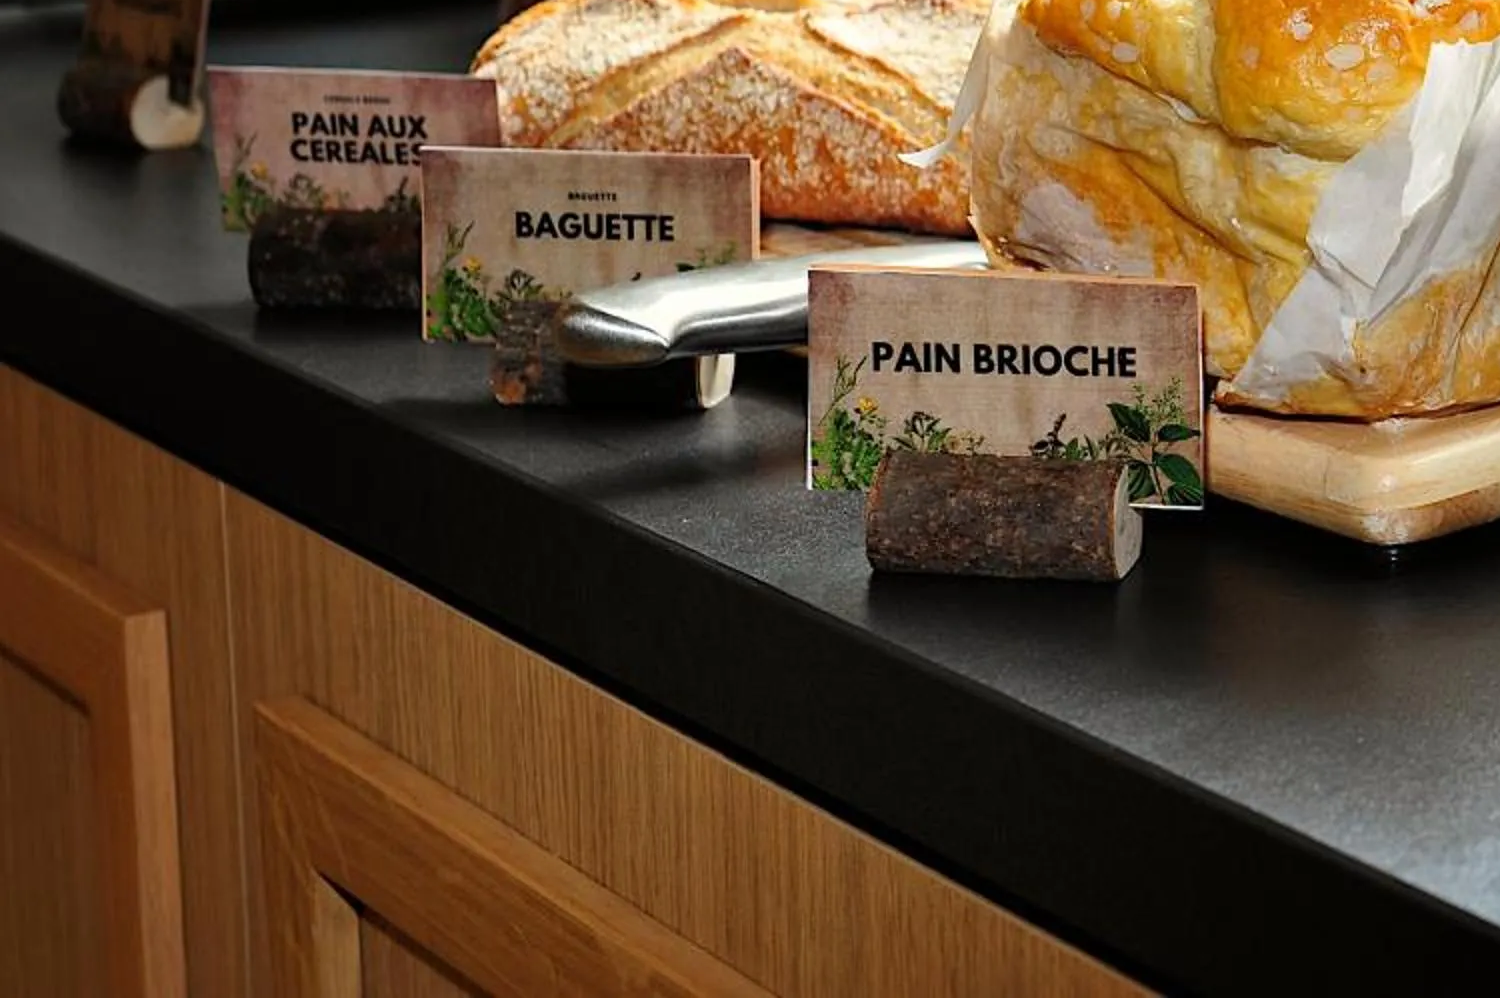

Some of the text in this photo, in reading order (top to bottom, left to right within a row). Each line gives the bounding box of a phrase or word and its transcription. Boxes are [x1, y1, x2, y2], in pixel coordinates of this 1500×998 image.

[291, 112, 428, 139] PAIN AUX
[567, 191, 617, 202] BAGUETTE
[515, 211, 675, 242] BAGUETTE
[871, 341, 1137, 378] PAIN BRIOCHE
